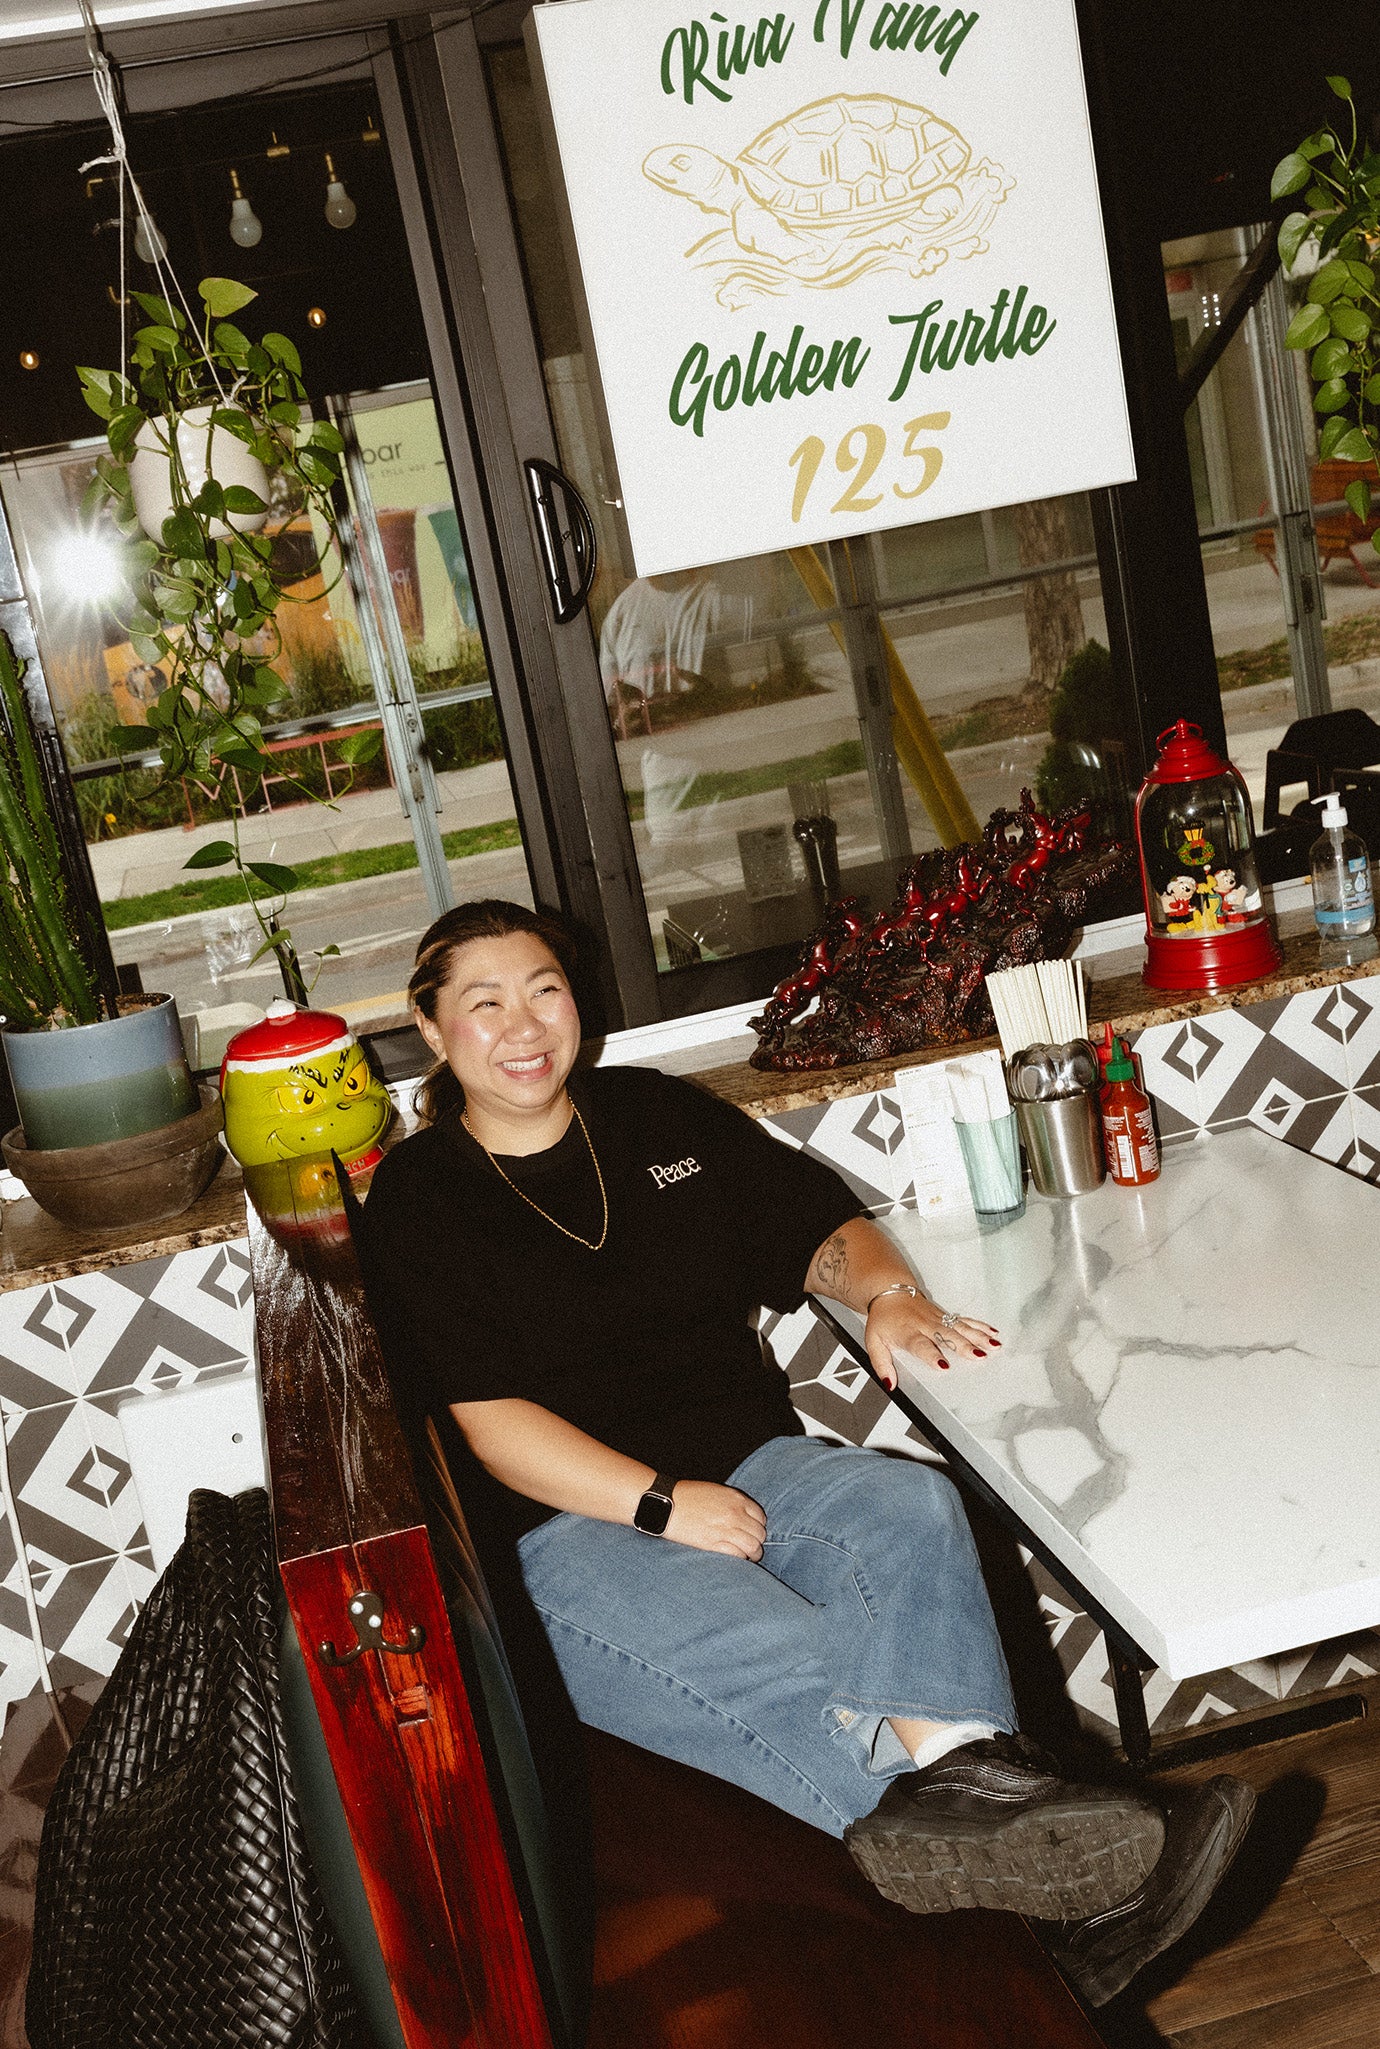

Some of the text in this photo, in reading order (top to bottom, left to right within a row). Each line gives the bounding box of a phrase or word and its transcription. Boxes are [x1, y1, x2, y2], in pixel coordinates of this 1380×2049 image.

[669, 285, 1056, 436] Golden Turtle
[789, 411, 951, 522] 125
[647, 1157, 702, 1190] Peace
